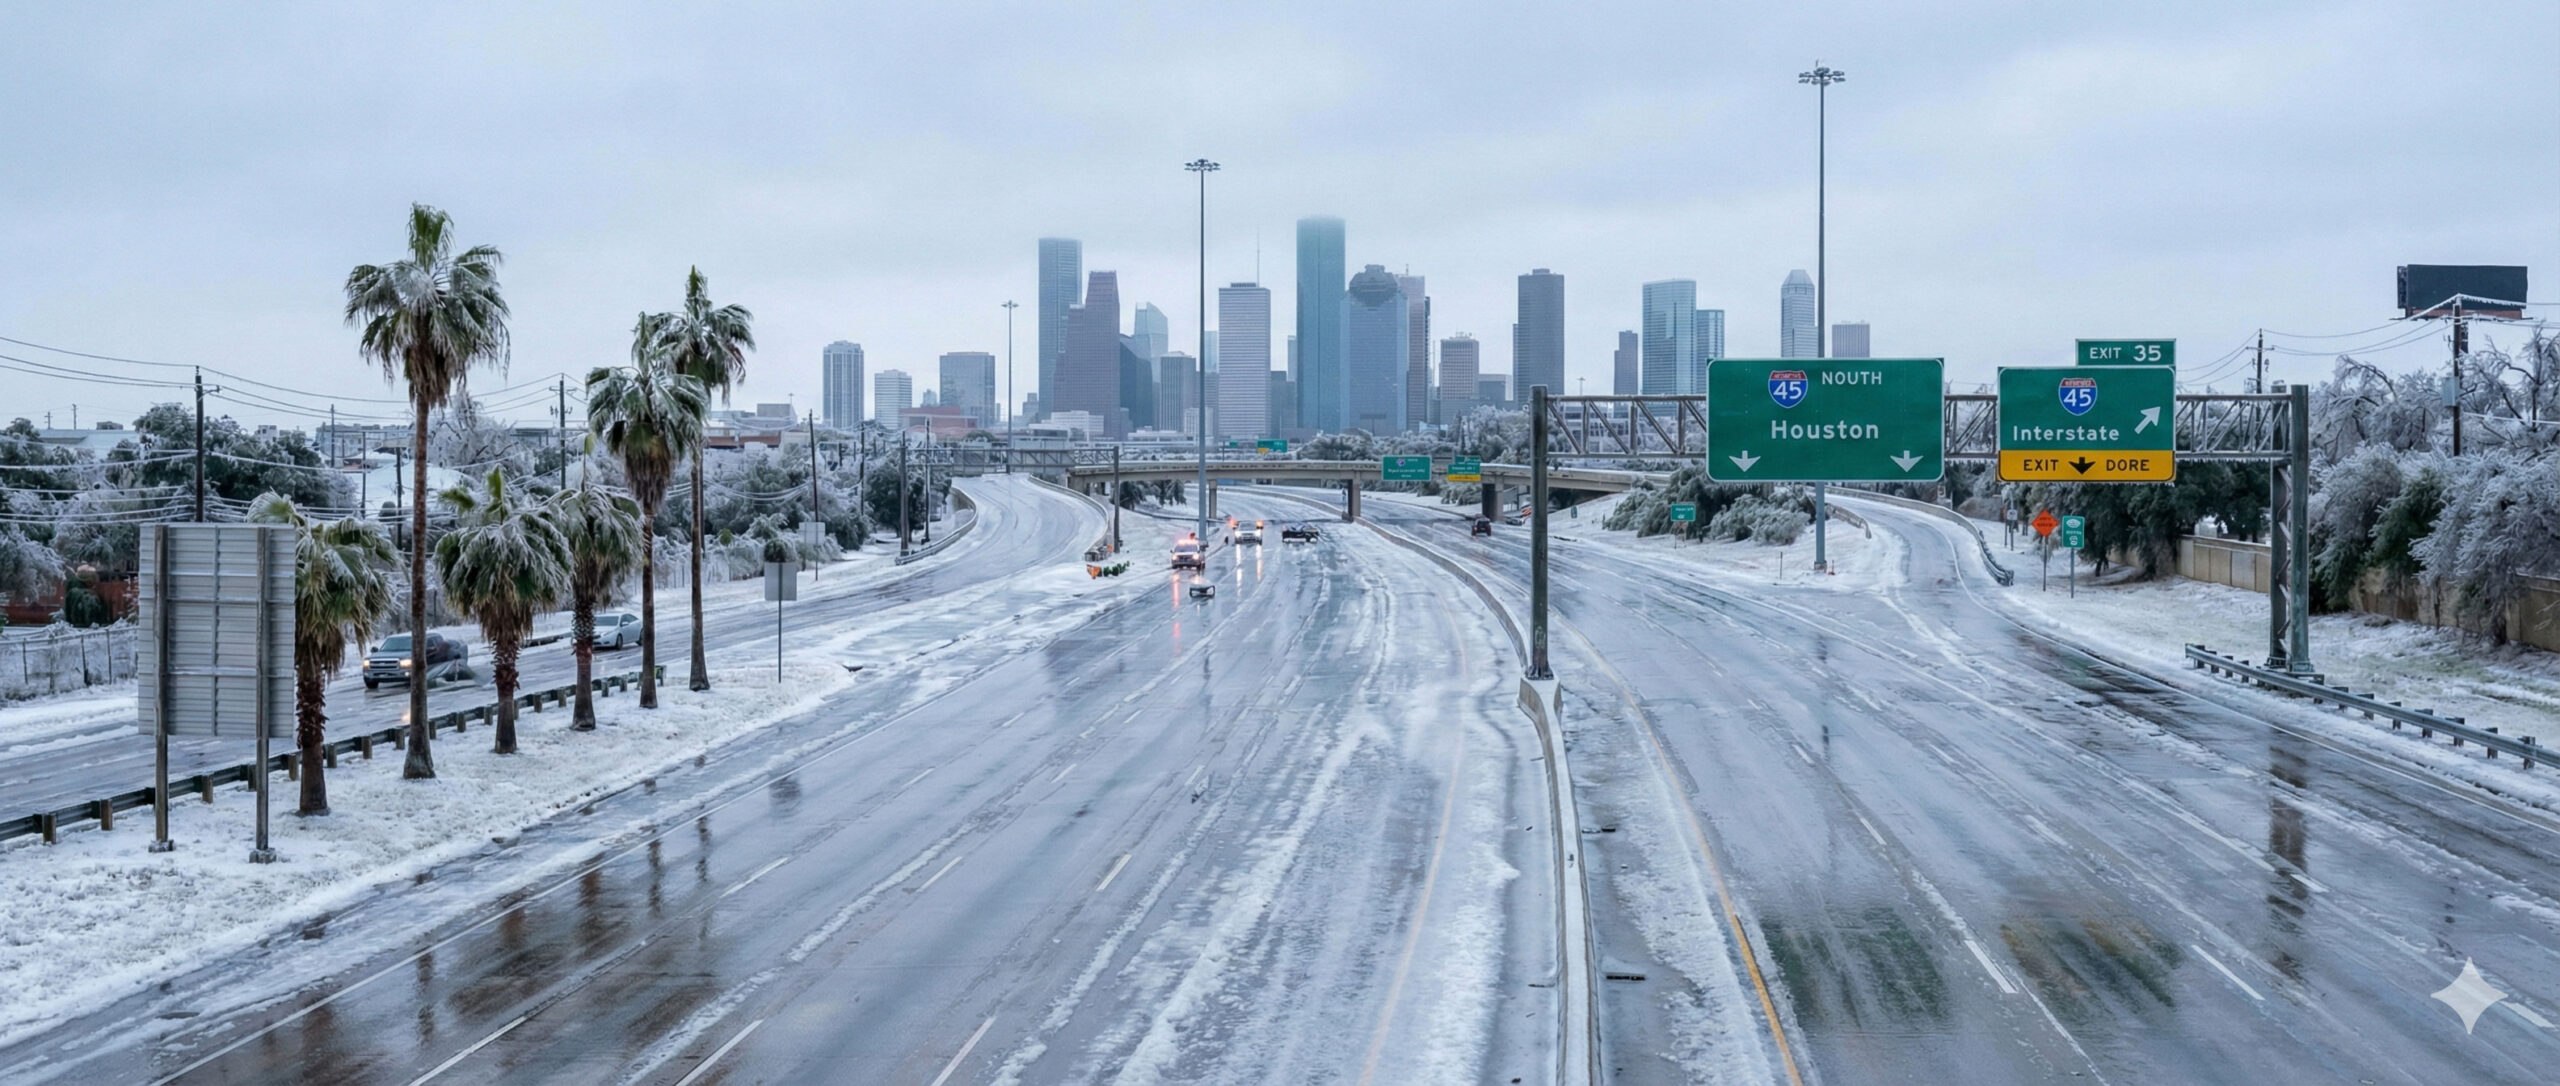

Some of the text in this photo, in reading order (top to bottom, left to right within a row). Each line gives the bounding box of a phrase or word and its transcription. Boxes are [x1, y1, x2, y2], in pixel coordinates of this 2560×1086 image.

[2089, 344, 2162, 362] EXIT 35
[1821, 371, 1882, 385] NOUTH
[1773, 380, 1802, 400] 45
[2063, 388, 2092, 407] 45
[1771, 419, 1879, 440] Houston
[2013, 425, 2120, 441] Interstate
[2023, 458, 2150, 472] EXIT DORE
